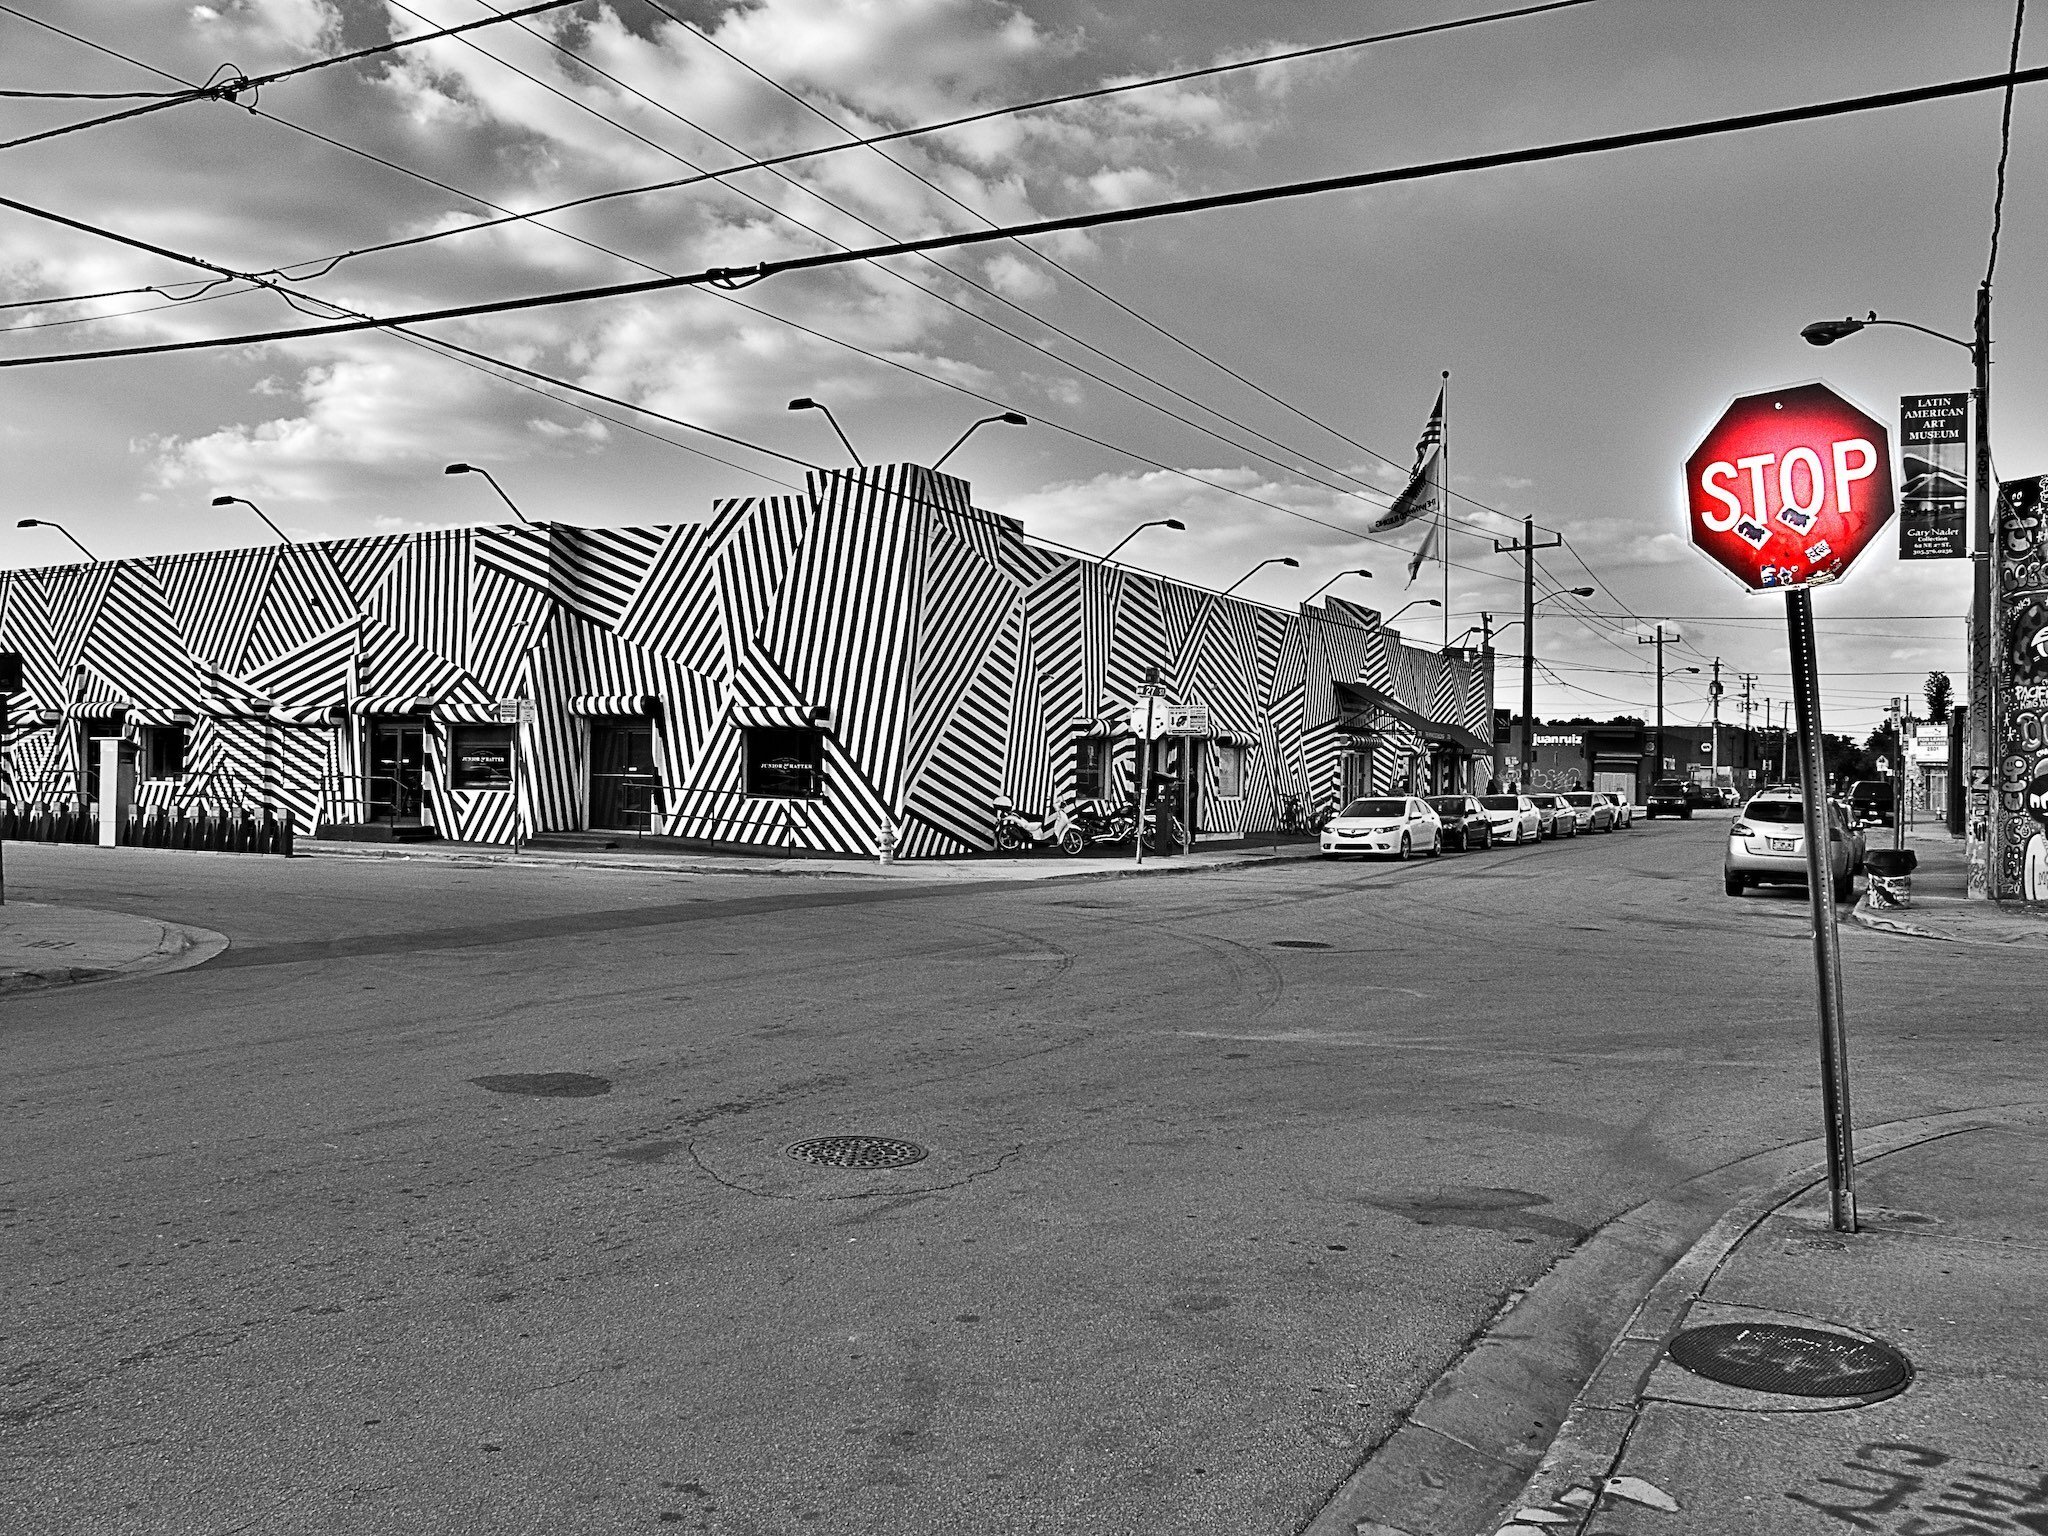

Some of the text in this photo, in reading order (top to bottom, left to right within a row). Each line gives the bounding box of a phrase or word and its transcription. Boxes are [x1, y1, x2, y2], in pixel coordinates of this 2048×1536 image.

[1917, 397, 1951, 408] LATIN
[1904, 407, 1965, 419] AMERICAN
[1922, 419, 1946, 429] ART
[1909, 429, 1960, 440] MUSEUM
[1701, 438, 1878, 532] STOP
[1907, 527, 1959, 537] Gary Nader
[1146, 686, 1156, 696] 27
[1532, 733, 1583, 747] juanruiz
[1158, 784, 1165, 794] P
